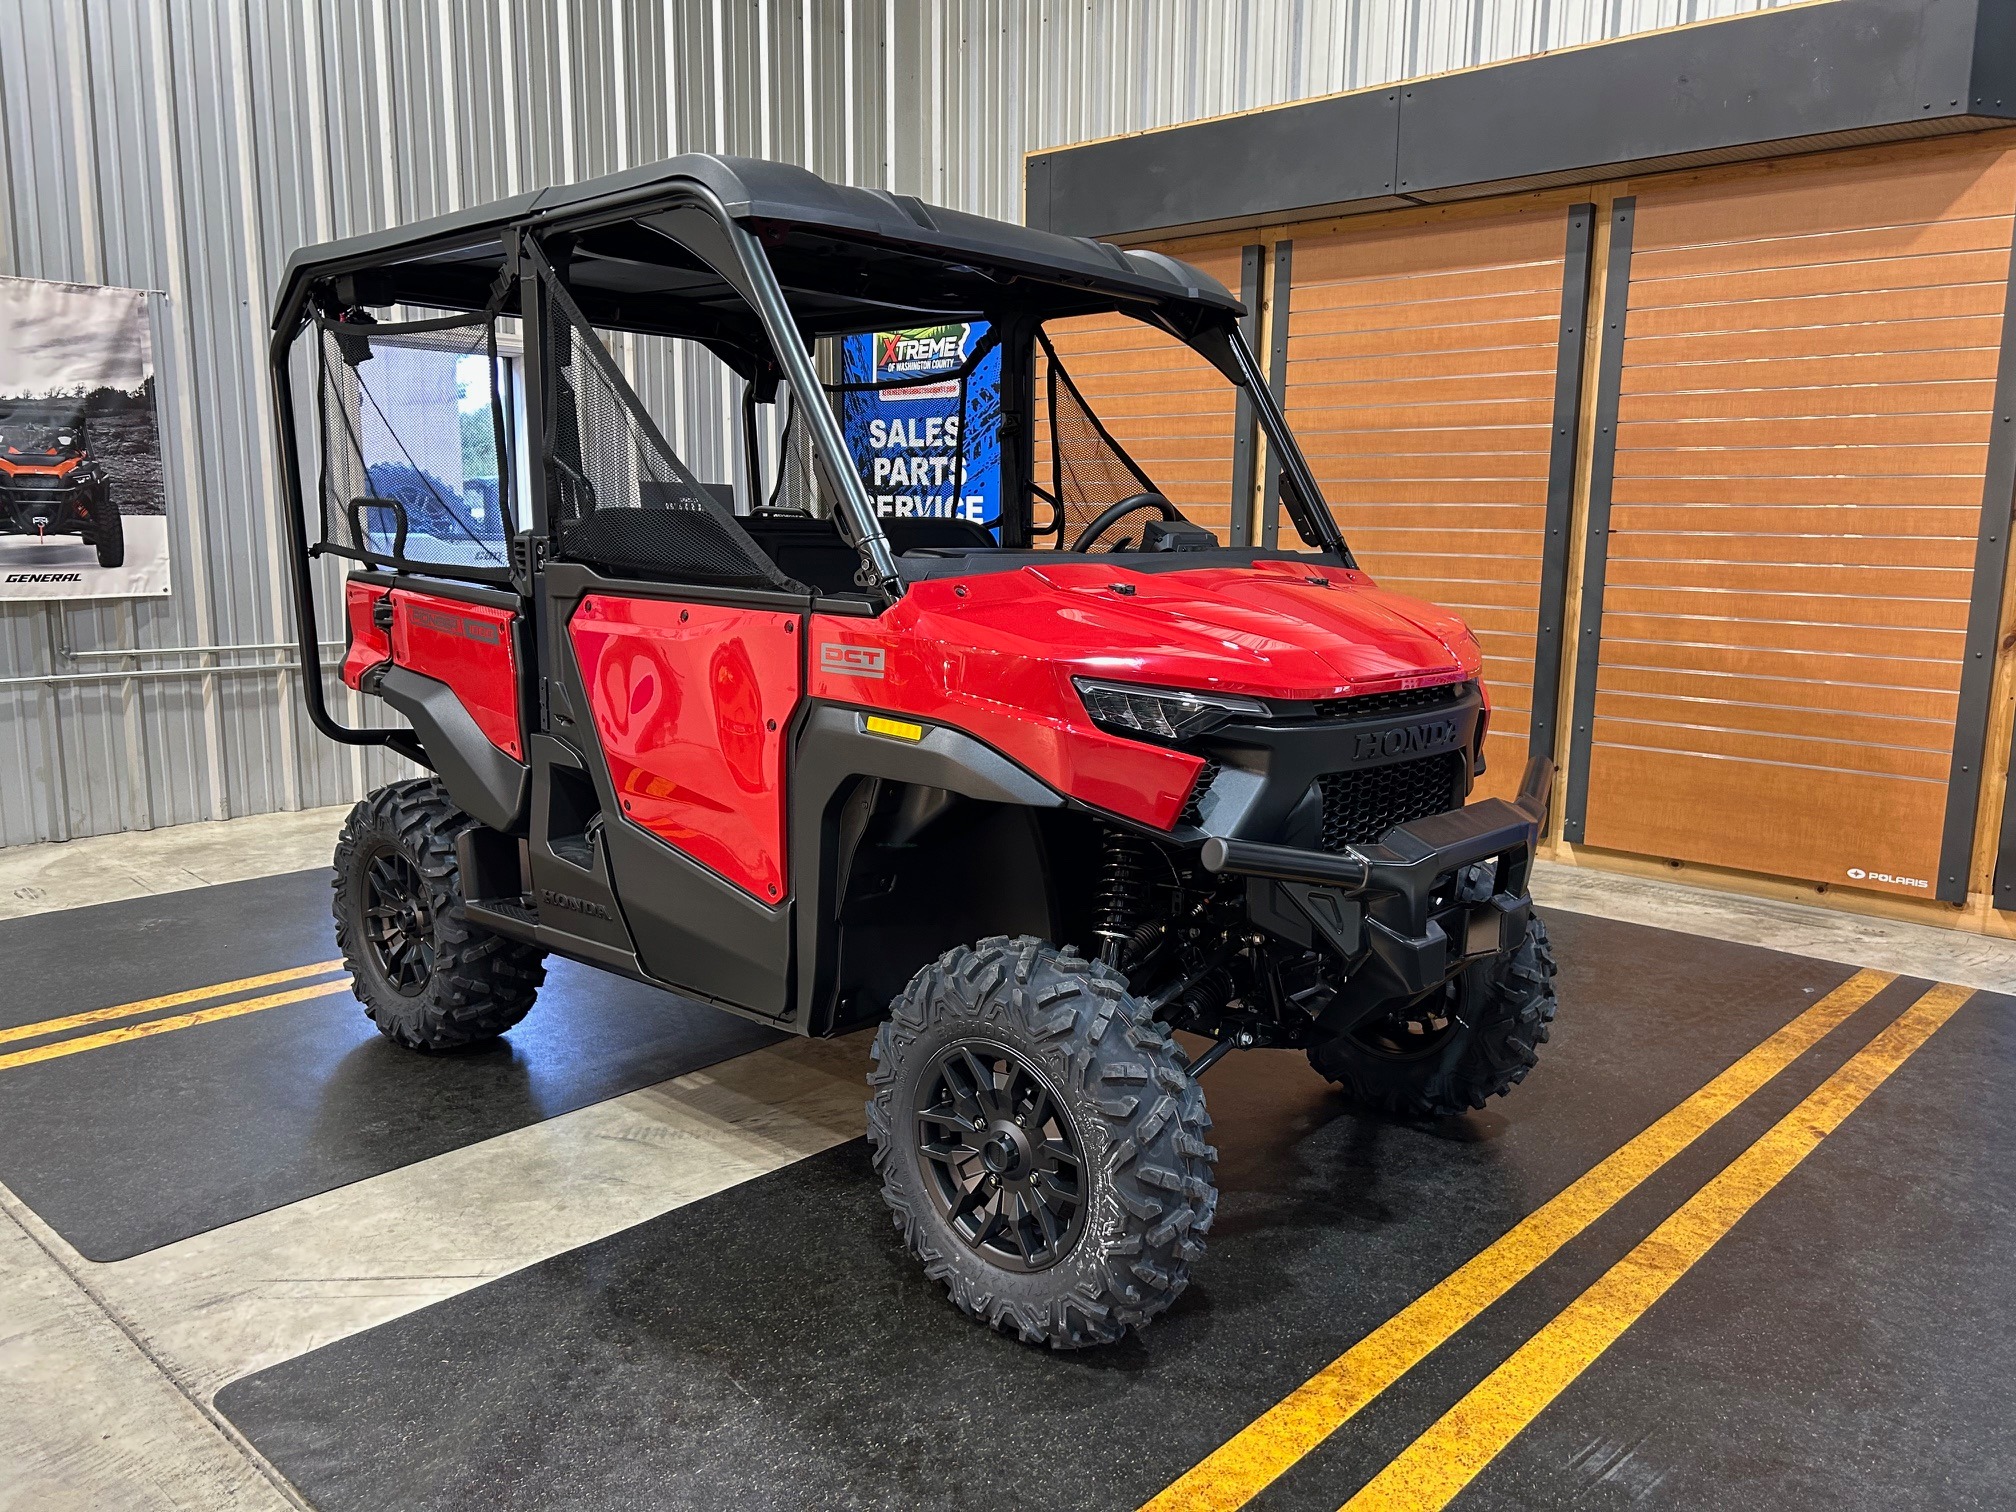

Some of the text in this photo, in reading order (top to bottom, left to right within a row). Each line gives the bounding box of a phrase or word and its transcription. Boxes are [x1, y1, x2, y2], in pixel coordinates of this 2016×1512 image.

[879, 335, 958, 366] XTREME
[887, 358, 955, 373] OF WASHINGTON COUNTY
[869, 416, 960, 448] SALES
[873, 455, 968, 486] PARTS
[5, 573, 82, 583] GENERAL
[825, 647, 881, 665] DCT
[1352, 718, 1458, 760] HONDA
[1868, 871, 1929, 889] POLARIS
[540, 888, 613, 921] HONDA
